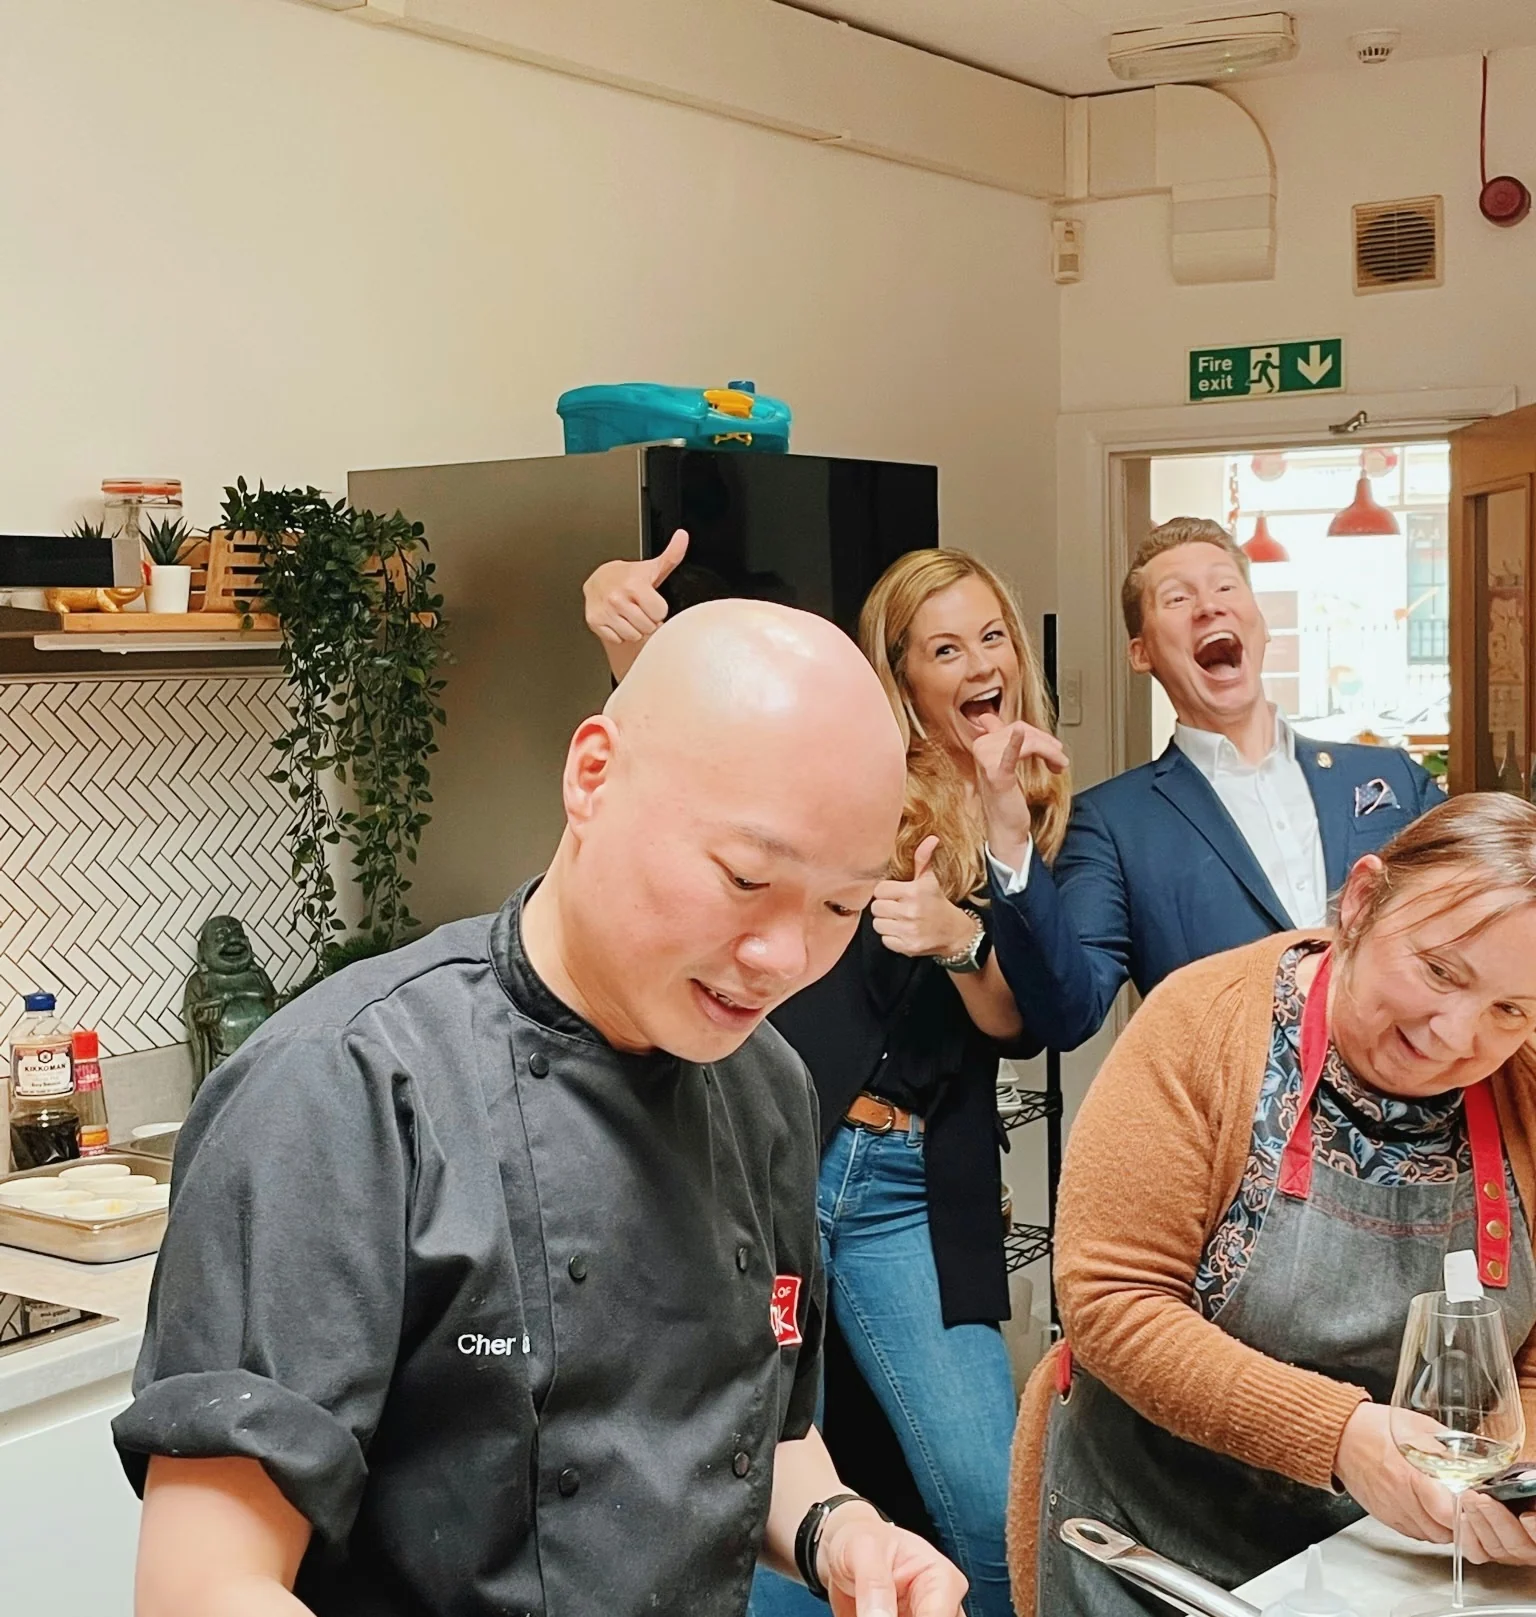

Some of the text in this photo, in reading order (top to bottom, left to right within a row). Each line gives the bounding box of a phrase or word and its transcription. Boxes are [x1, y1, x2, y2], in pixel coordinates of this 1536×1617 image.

[1198, 356, 1233, 373] Fire
[1198, 375, 1233, 391] exit
[24, 1063, 66, 1072] KIKKOMAN
[777, 1286, 792, 1298] OF
